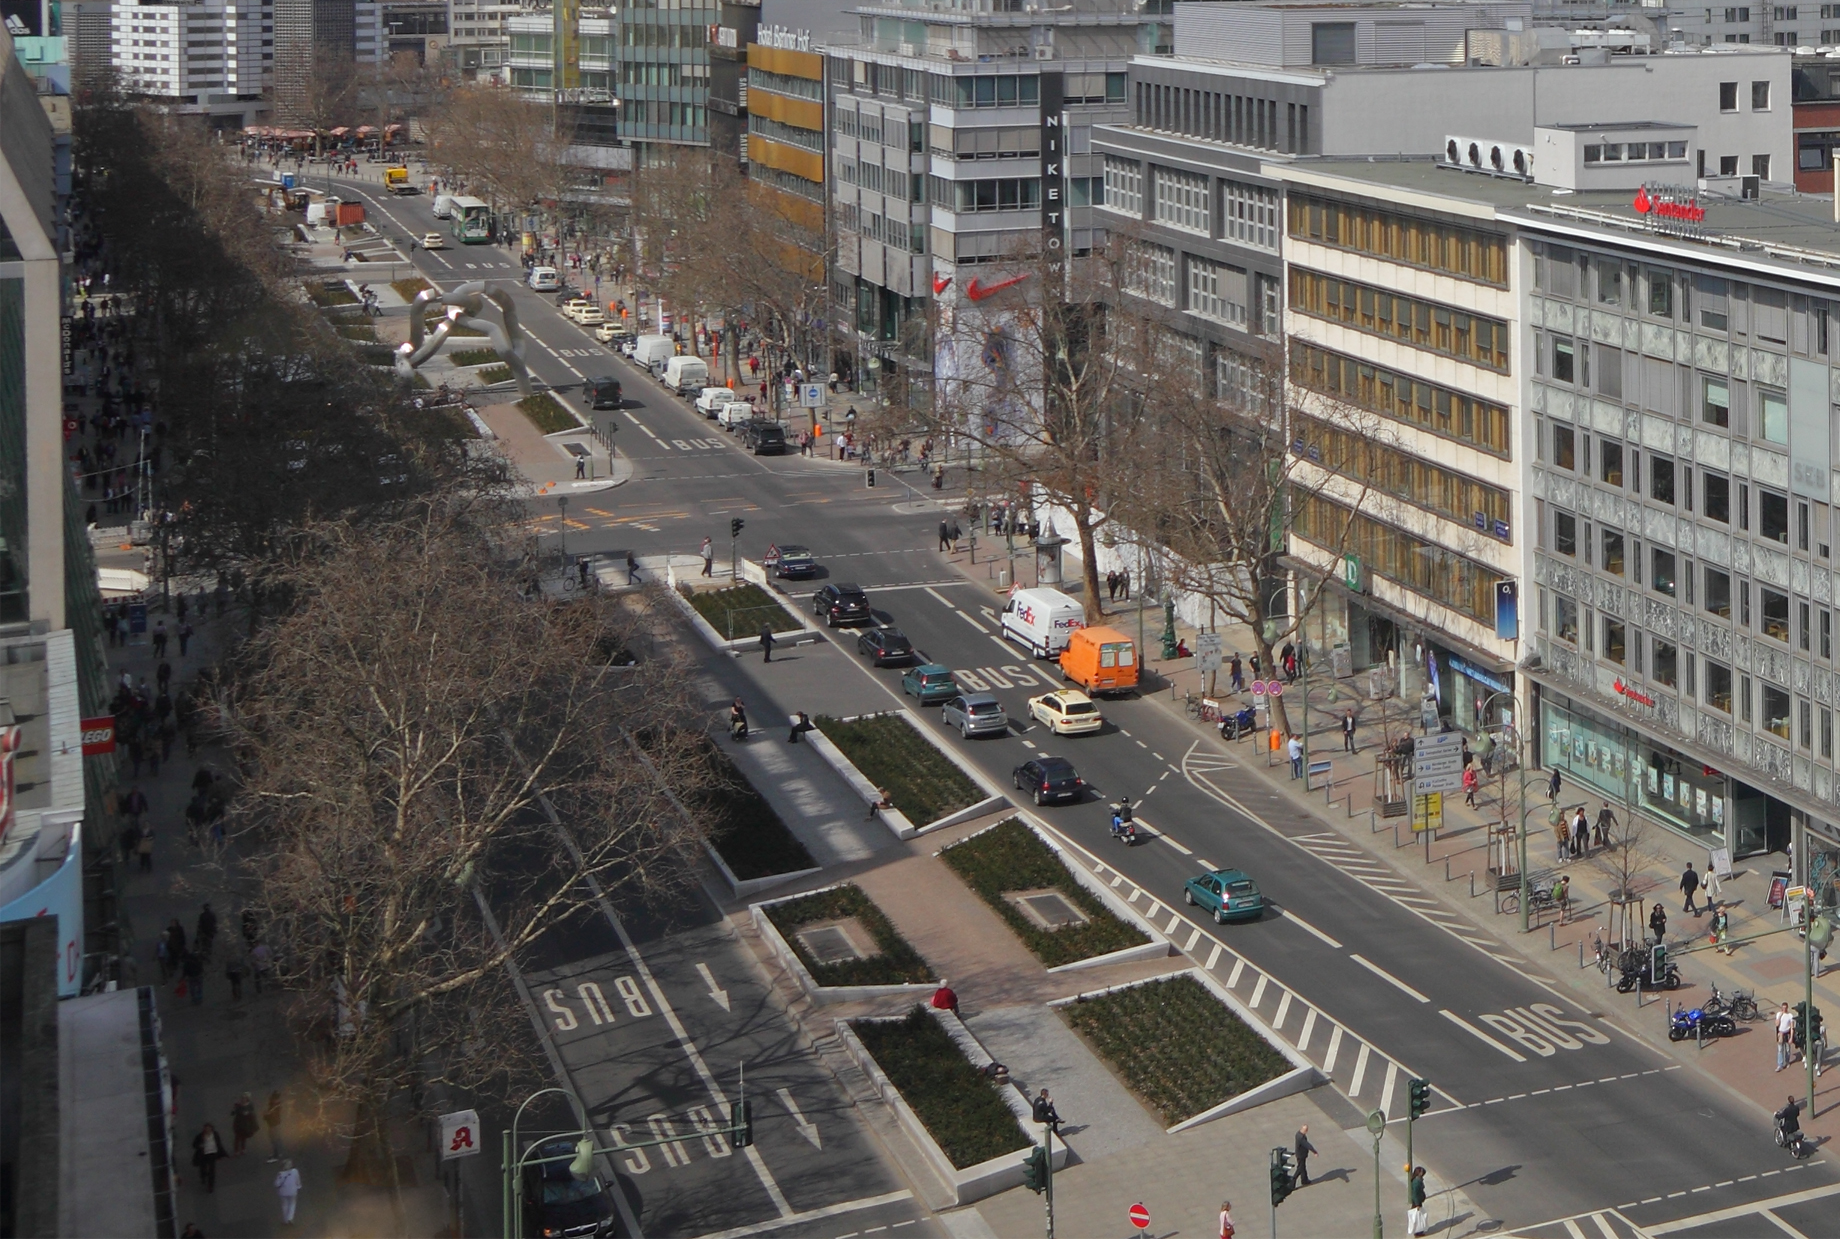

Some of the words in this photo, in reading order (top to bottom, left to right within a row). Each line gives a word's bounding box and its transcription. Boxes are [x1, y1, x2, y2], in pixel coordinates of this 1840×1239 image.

[739, 78, 747, 107] SATURN
[739, 133, 748, 163] SATURN
[1046, 116, 1061, 297] NIKETOWN
[1652, 194, 1705, 222] Santander
[559, 347, 605, 358] BUS
[672, 437, 727, 451] BUS
[1017, 600, 1036, 627] FedEx
[1054, 618, 1081, 629] FedEx
[953, 665, 1040, 692] BUS
[543, 975, 653, 1031] BUS
[1478, 1003, 1611, 1057] BUS
[610, 1104, 732, 1175] BUS
